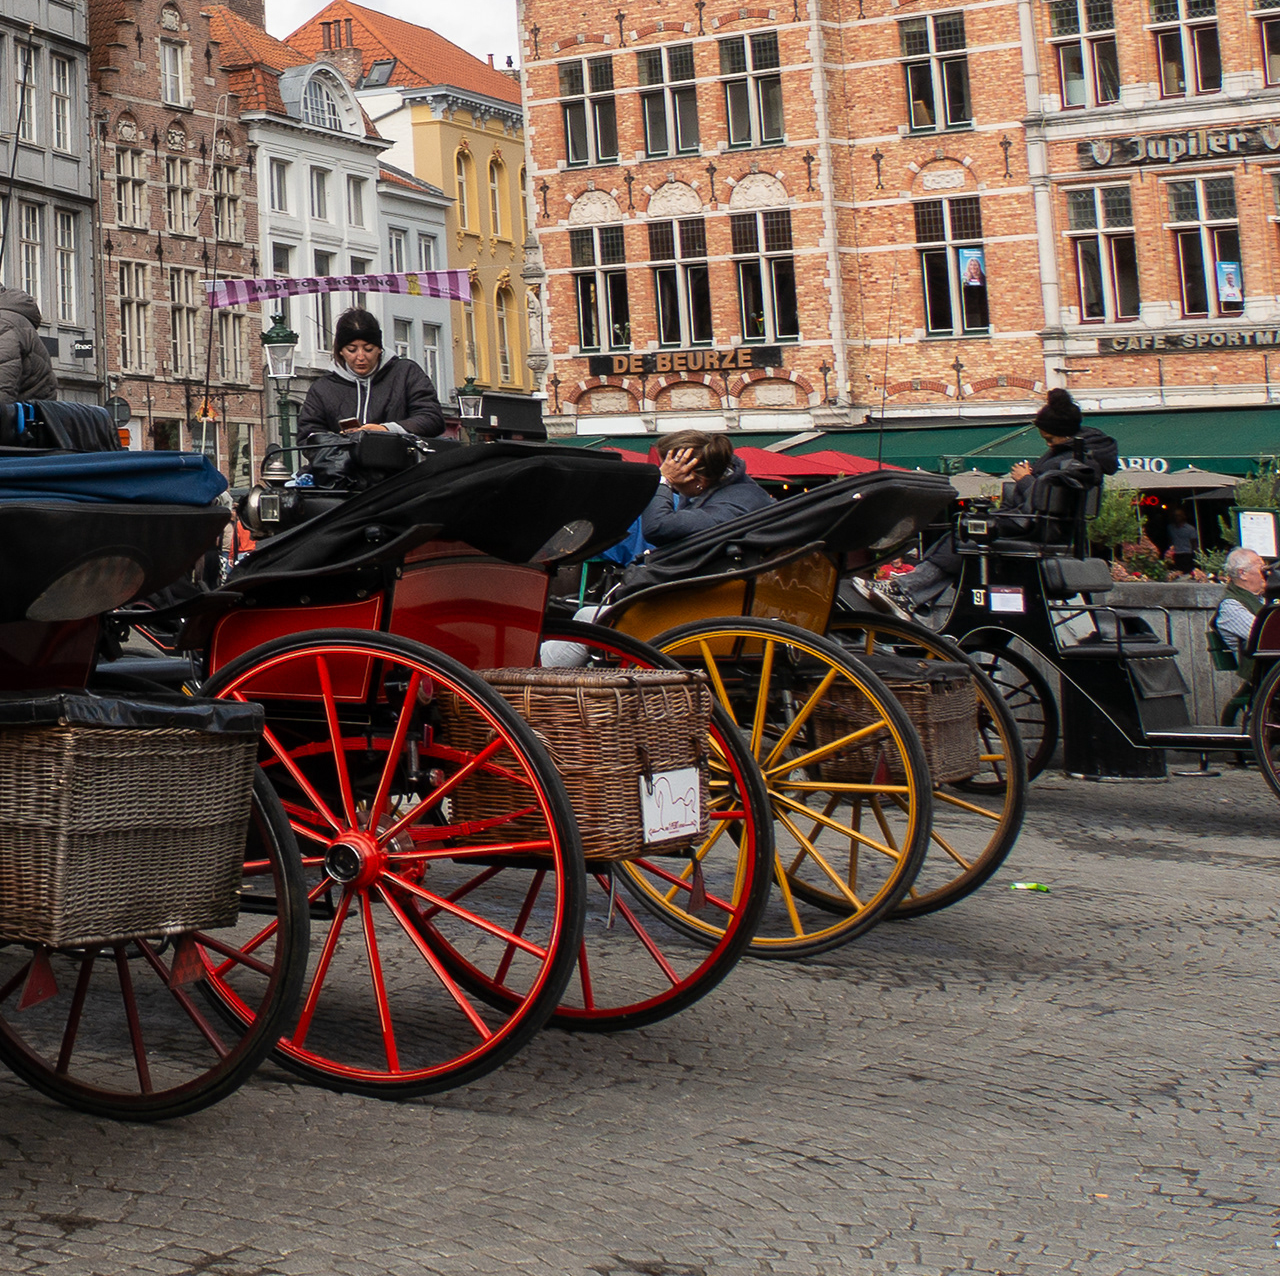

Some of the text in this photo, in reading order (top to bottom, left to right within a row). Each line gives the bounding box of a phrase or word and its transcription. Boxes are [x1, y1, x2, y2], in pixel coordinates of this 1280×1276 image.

[1129, 131, 1248, 163] Jupiler
[251, 276, 395, 294] MADE FOR SHOPPING
[1112, 335, 1167, 351] CAFE
[612, 348, 753, 374] DE BEURZE
[1118, 458, 1168, 473] ARIO
[975, 591, 982, 603] 9
